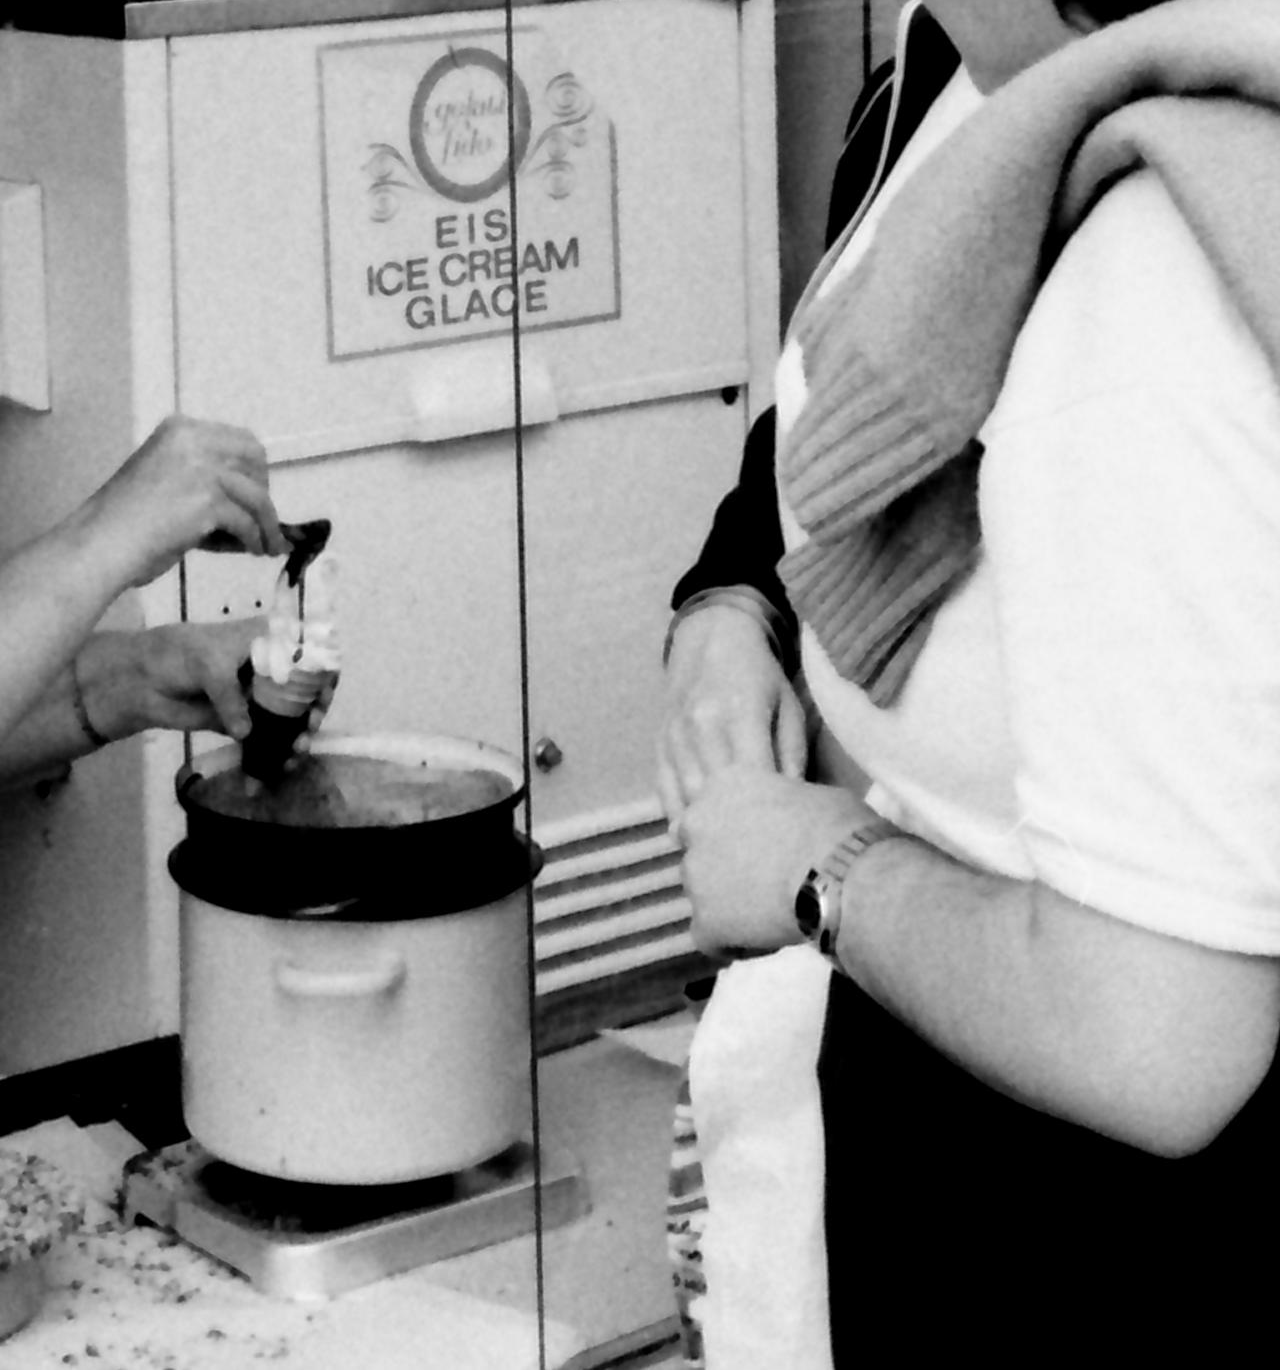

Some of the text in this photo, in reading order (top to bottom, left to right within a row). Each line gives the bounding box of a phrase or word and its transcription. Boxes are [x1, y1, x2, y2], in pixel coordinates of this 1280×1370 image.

[435, 209, 508, 249] EIS
[367, 237, 579, 296] ICE CREAM
[405, 280, 548, 330] GLACE
